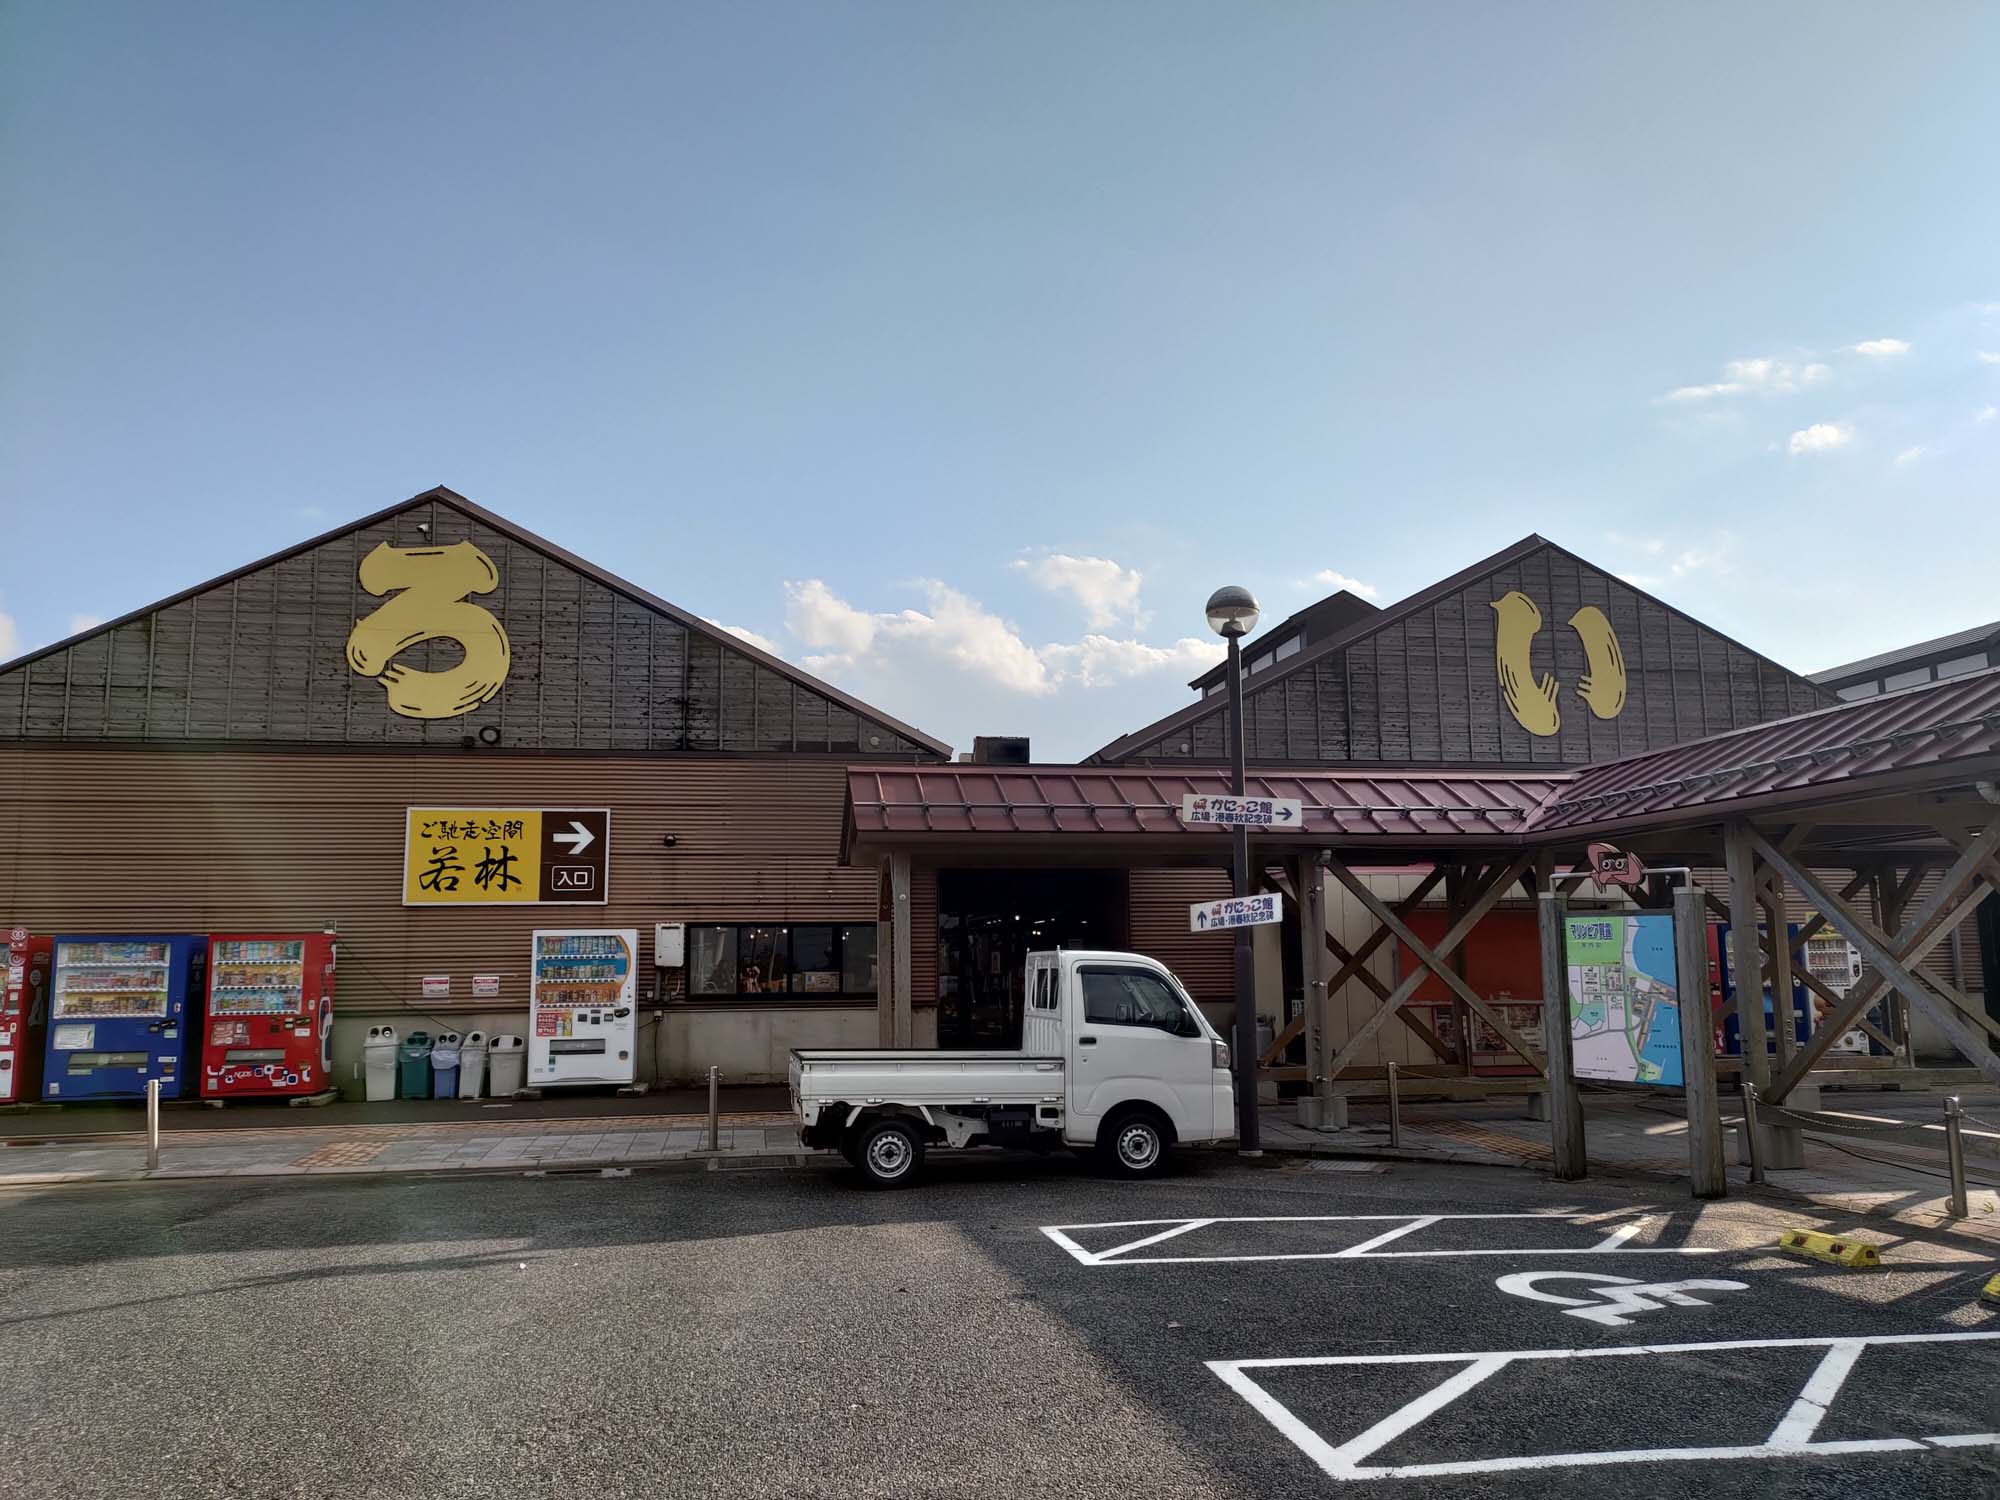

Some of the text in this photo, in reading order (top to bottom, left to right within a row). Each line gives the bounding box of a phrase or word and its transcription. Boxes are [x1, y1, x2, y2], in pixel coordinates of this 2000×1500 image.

[346, 540, 511, 719] ろ
[1489, 591, 1627, 737] い
[1210, 798, 1273, 814] かにっこ館
[421, 820, 524, 840] ご馳走空間
[418, 845, 522, 893] 若林
[557, 871, 588, 886] 入口
[1224, 897, 1273, 914] かにっこ館
